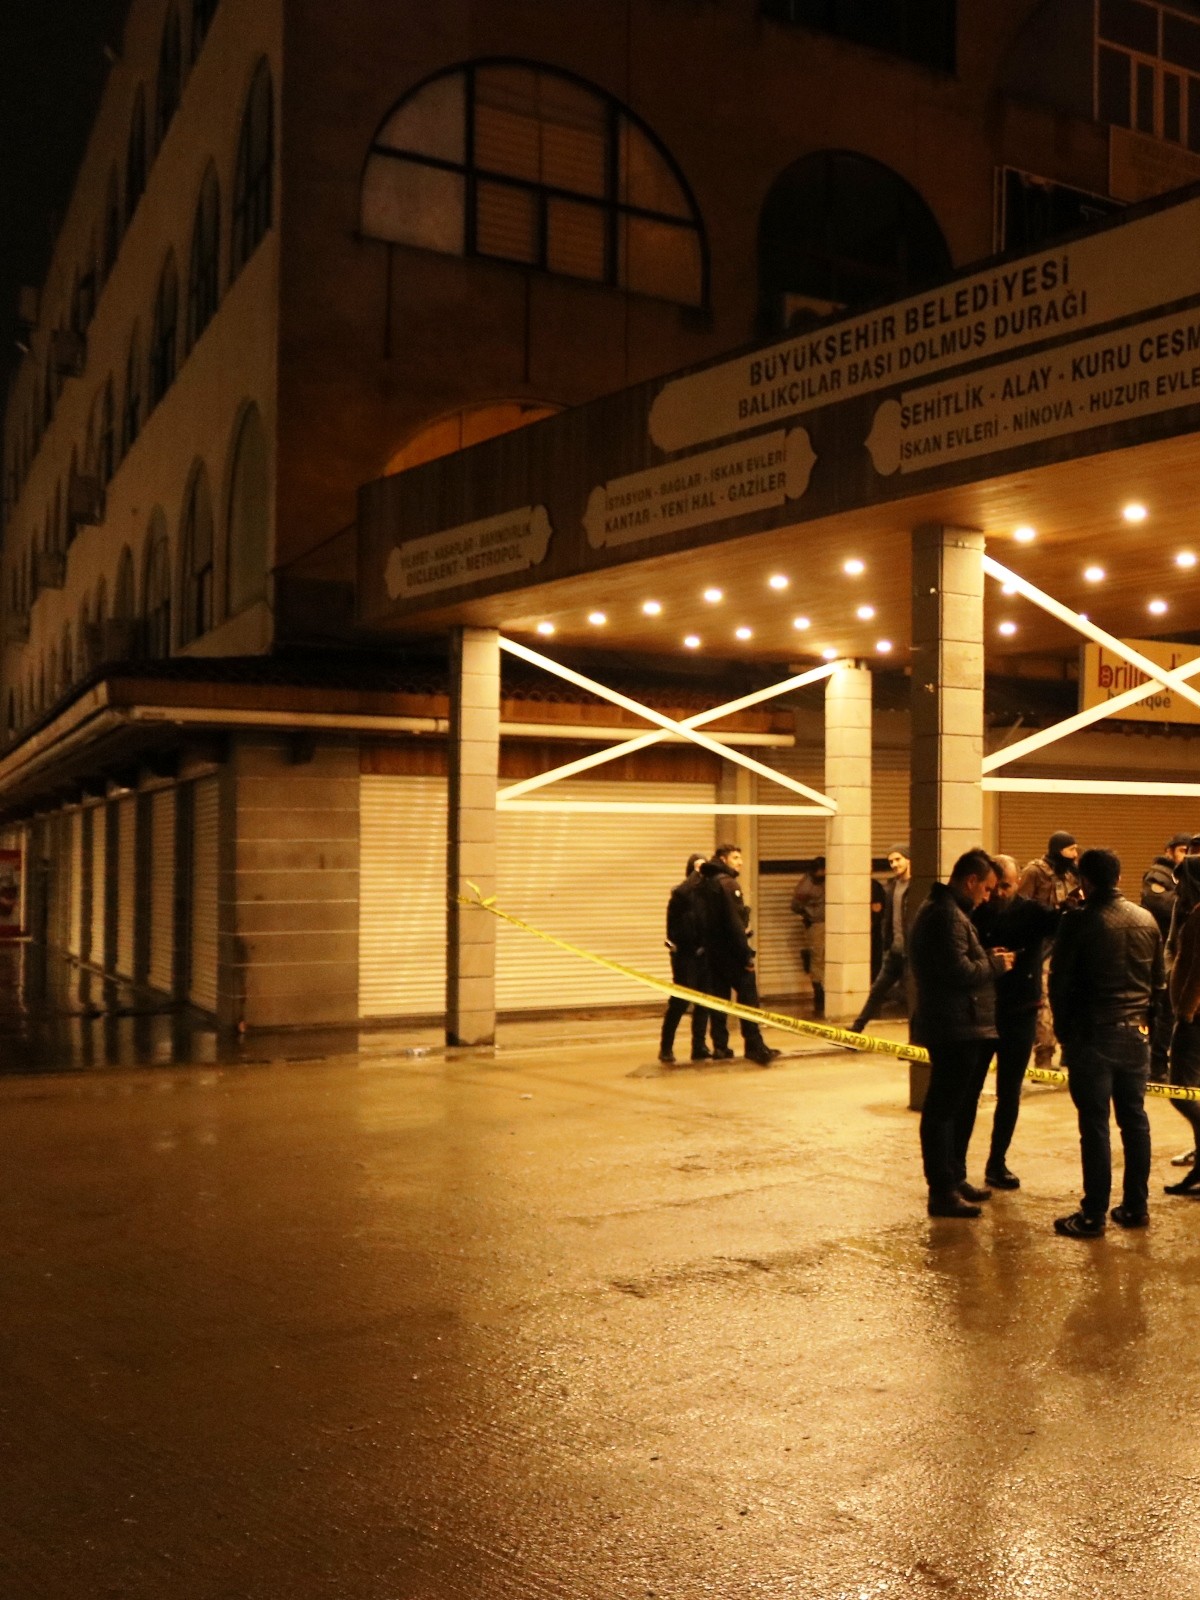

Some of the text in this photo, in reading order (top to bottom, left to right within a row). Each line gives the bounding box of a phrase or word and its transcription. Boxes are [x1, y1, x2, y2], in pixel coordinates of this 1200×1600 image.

[738, 290, 1087, 420] BALIKÇILAR BAŞI DOLMUŞ DURAĞI
[749, 254, 1070, 387] BÜYÜKŞEHİR BELEDİYESİ
[900, 434, 942, 461] İSKAN
[946, 416, 1001, 451] EVLERİ
[1013, 400, 1074, 433] NİNOVA
[1089, 379, 1151, 412] HUZUR
[901, 381, 984, 430] ŞEHİTLİK
[1002, 365, 1052, 401] ALAY
[1071, 344, 1131, 382] KURU
[604, 510, 650, 533] KANTAR
[660, 496, 689, 519] YENİ
[691, 494, 716, 511] HAL
[728, 471, 787, 501] GAZİLER
